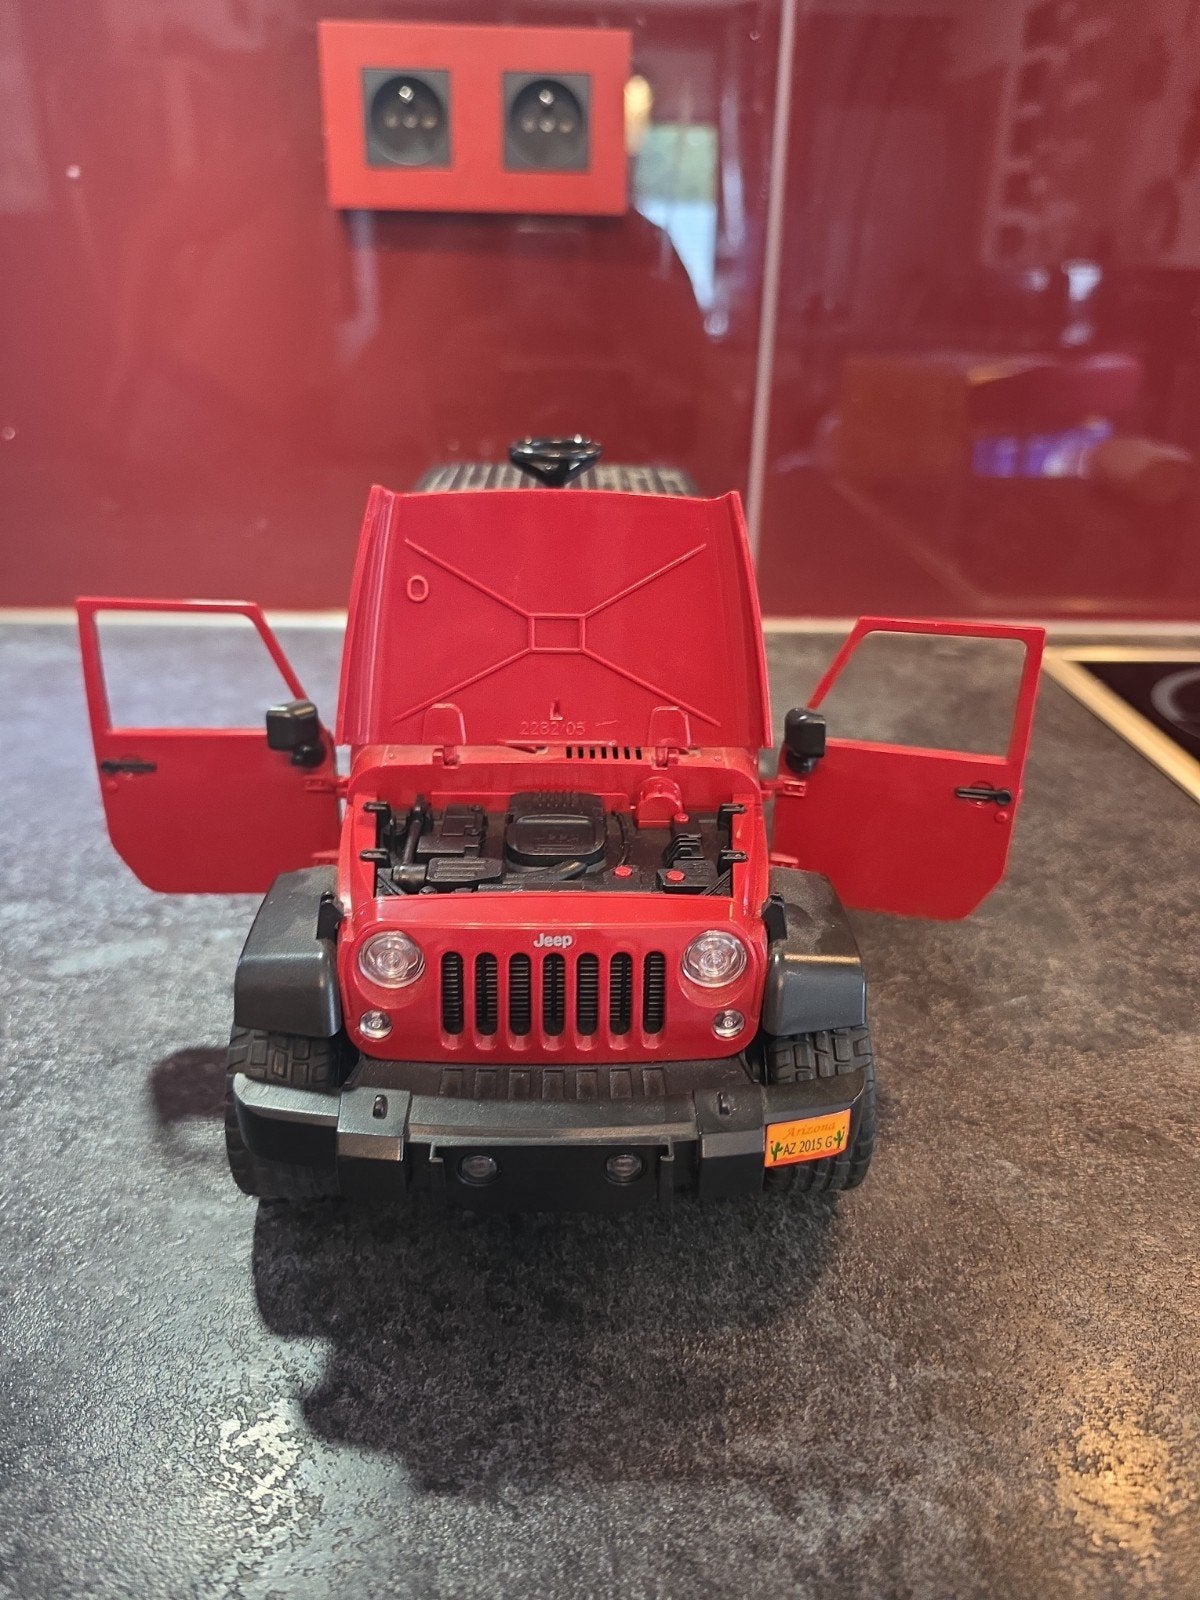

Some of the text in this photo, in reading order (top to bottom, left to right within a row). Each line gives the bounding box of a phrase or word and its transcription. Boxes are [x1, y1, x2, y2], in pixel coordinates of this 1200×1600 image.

[533, 932, 573, 949] Jeep
[783, 1121, 836, 1139] Arizona
[783, 1135, 833, 1156] AZ 2015 G
